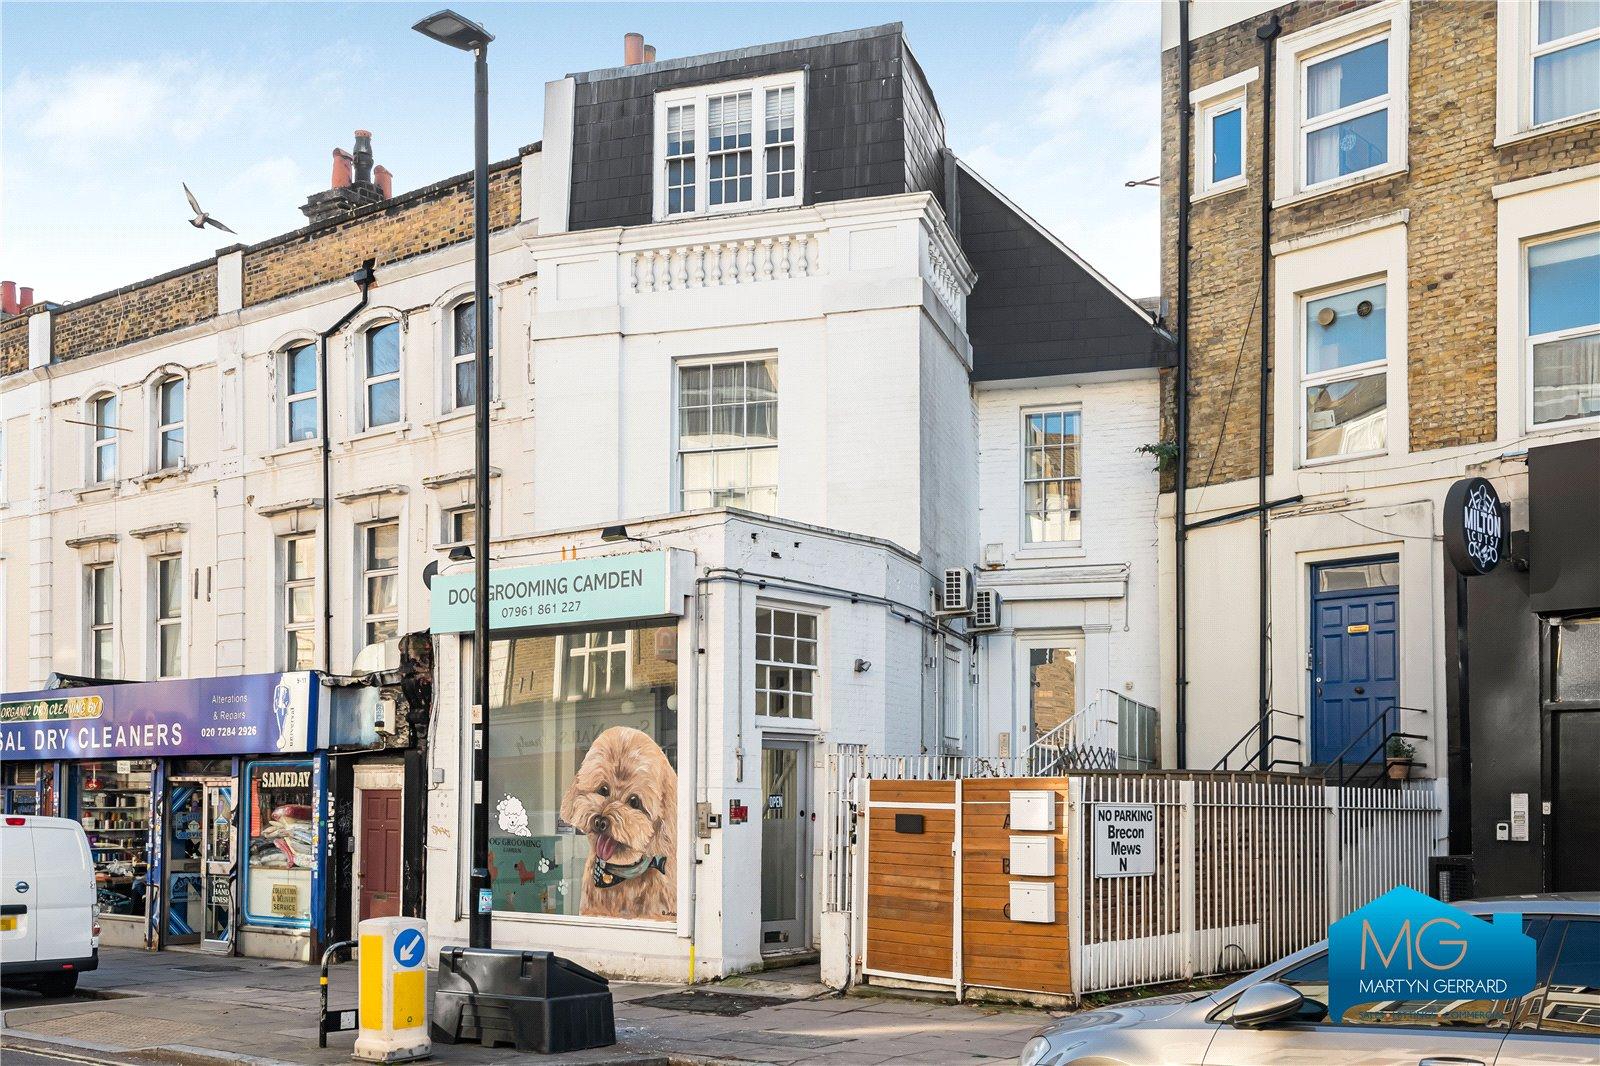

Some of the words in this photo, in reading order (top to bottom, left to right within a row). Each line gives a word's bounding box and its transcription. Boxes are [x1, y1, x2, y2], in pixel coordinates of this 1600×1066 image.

[1464, 505, 1501, 538] MILTON
[1471, 530, 1494, 546] CUTS
[573, 568, 643, 592] CAMDEN
[502, 607, 533, 618] 07961
[538, 604, 557, 614] 861
[562, 601, 581, 613] 227
[212, 695, 248, 704] Alterations
[0, 705, 31, 718] ORGANIC
[213, 712, 217, 720] &
[220, 711, 246, 721] Repairs
[35, 729, 69, 750] DRY
[78, 723, 182, 749] CLEANERS
[202, 728, 216, 737] 020
[218, 727, 236, 736] 7284
[238, 726, 257, 736] 2926
[262, 771, 311, 788] SAMEDAY
[769, 796, 783, 808] OPEN
[1098, 809, 1112, 822] NO
[1114, 809, 1153, 822] PARKING
[1107, 824, 1145, 839] Brecon
[489, 837, 500, 846] OG
[501, 838, 541, 848] GROOMING
[1111, 841, 1142, 856] Mews
[1119, 857, 1128, 872] N
[273, 903, 296, 911] SERVICE
